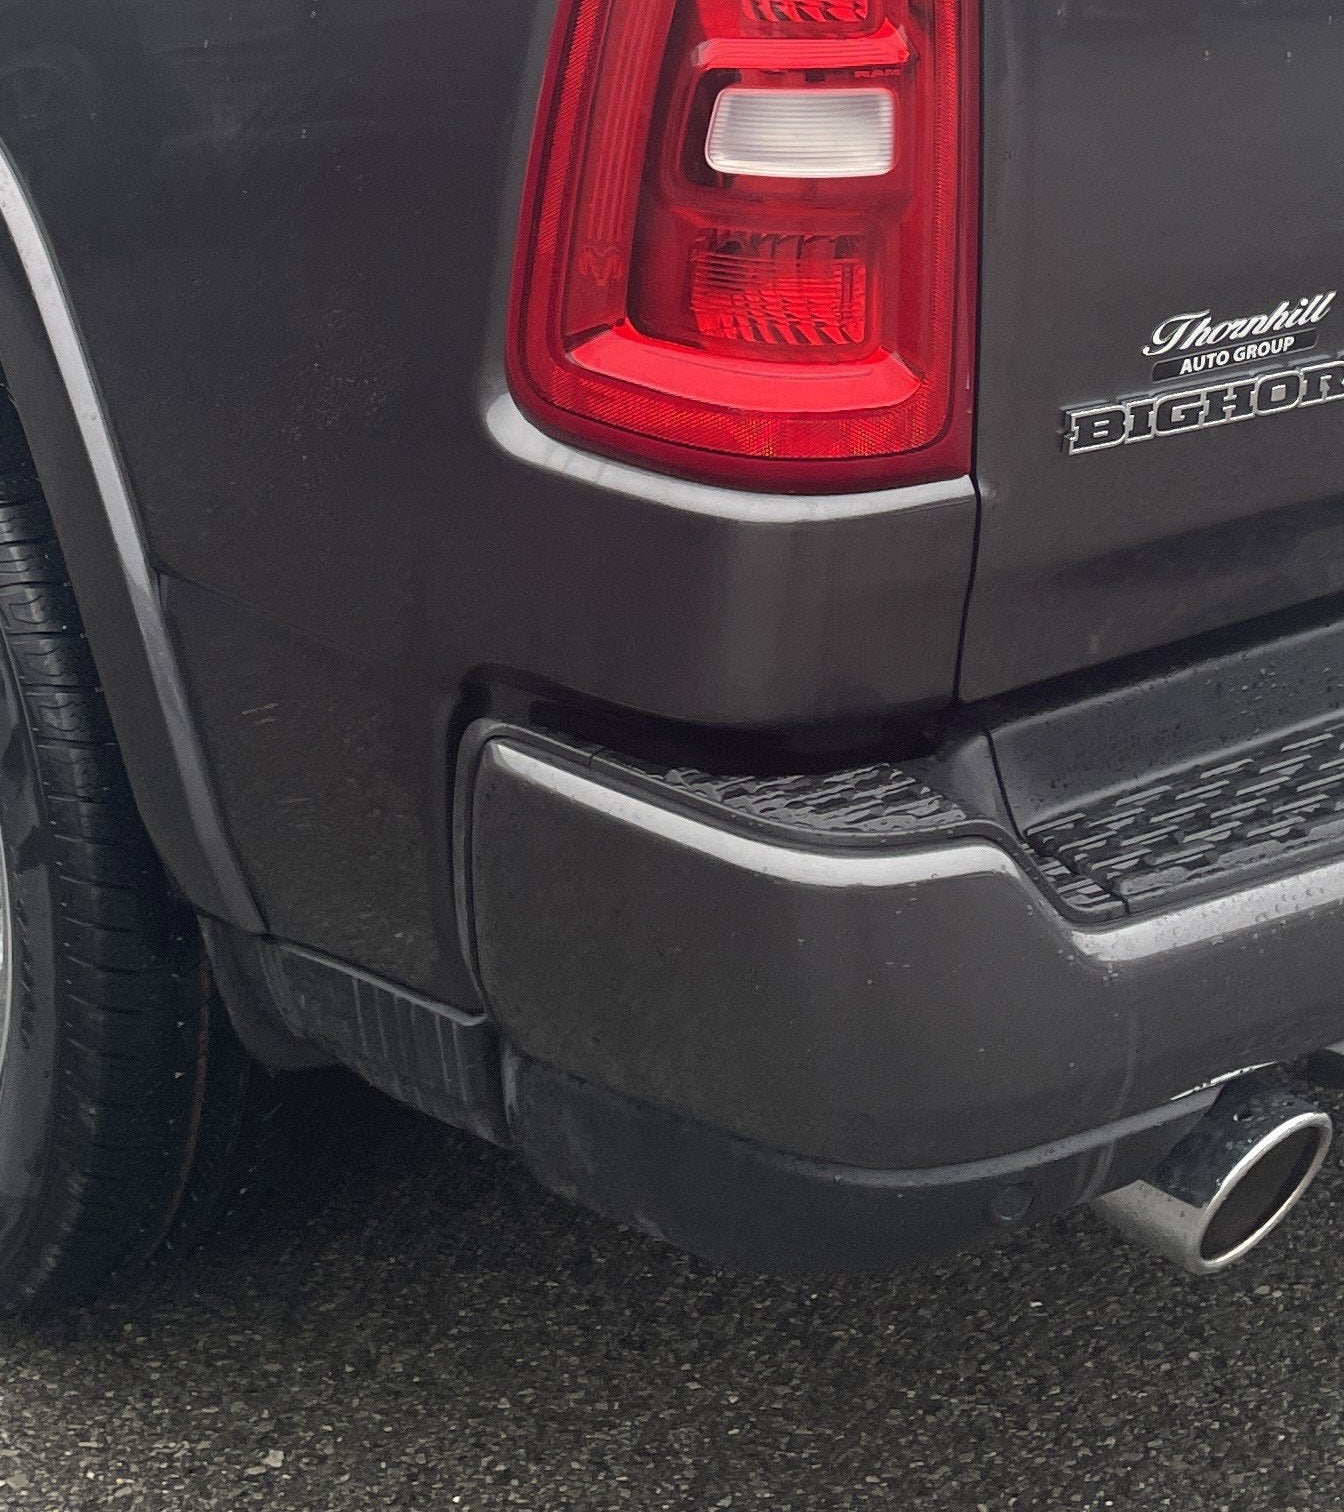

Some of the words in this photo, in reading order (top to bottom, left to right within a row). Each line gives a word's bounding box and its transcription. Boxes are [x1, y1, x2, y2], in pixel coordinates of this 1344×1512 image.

[1142, 291, 1338, 357] Thornhill
[1179, 349, 1230, 375] AUTO
[1232, 335, 1295, 363] GROUP
